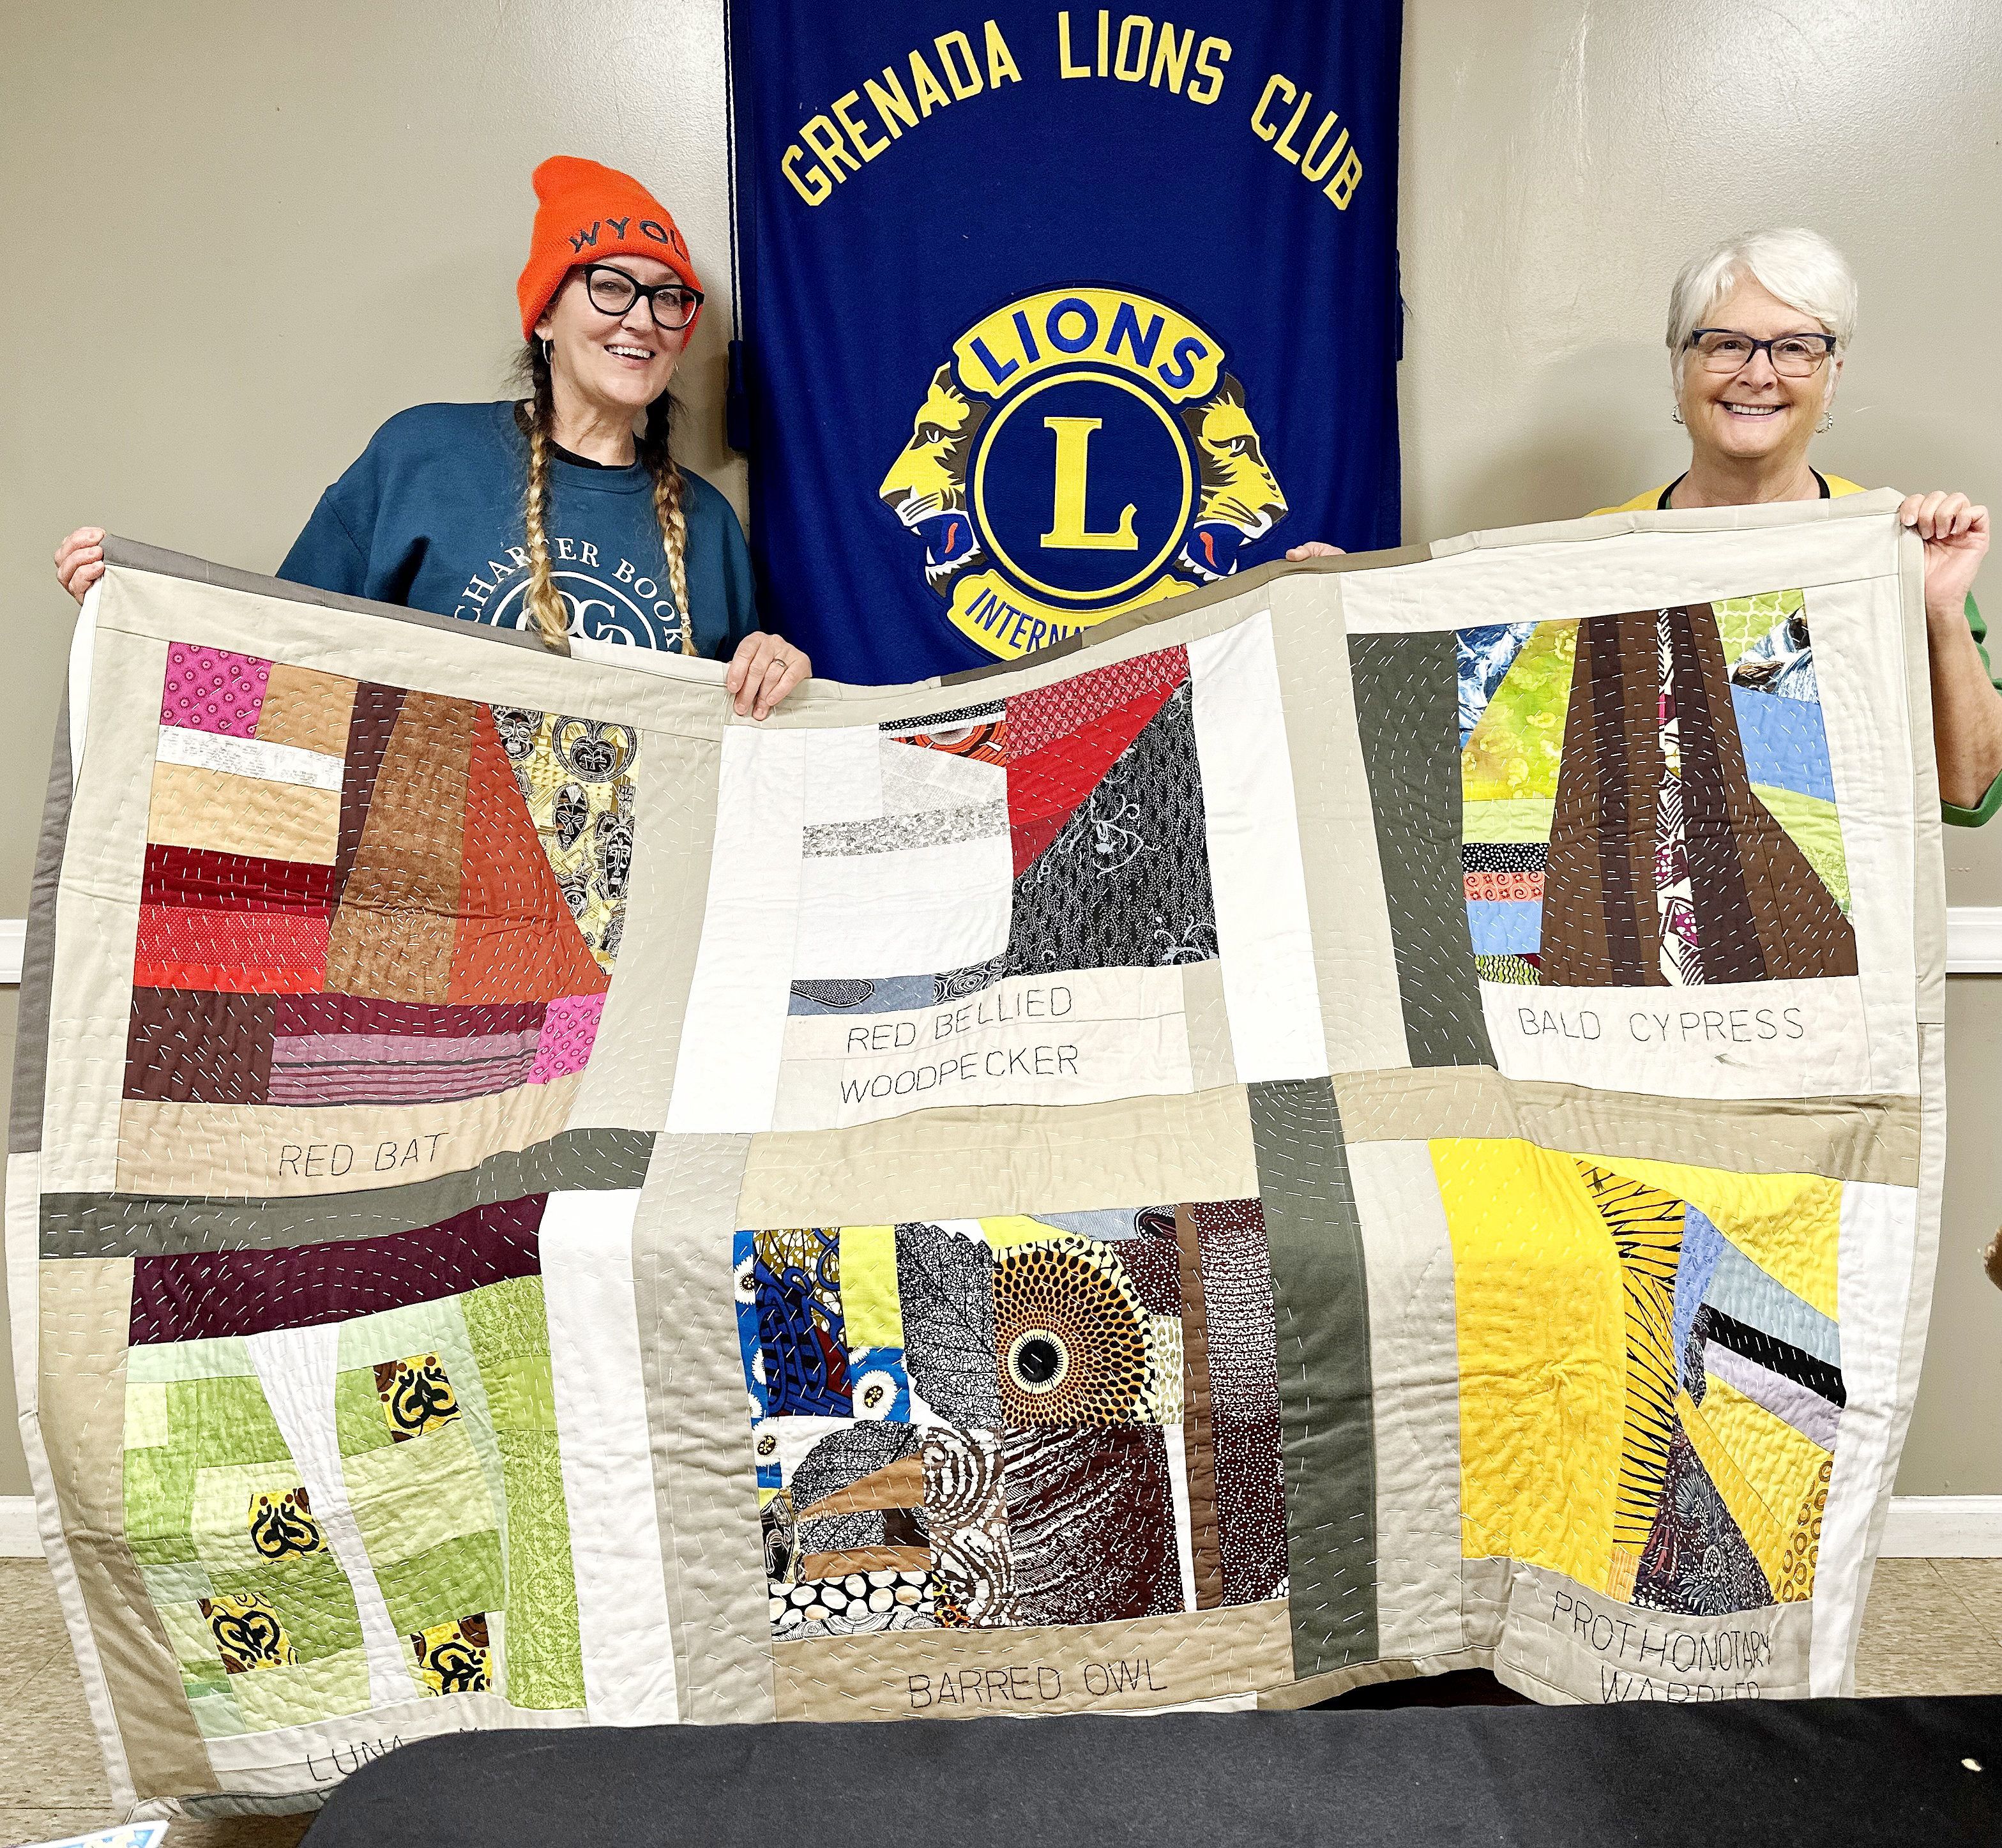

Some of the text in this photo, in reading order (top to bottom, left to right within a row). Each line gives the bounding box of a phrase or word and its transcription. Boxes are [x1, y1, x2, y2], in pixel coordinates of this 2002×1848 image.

[782, 10, 1362, 211] GRENADA LIONS CLUB
[970, 298, 1208, 390] LIONS
[1040, 416, 1139, 550] L
[454, 538, 600, 623] CHARER
[612, 558, 683, 653] BOOK
[964, 587, 1095, 653] INTERN
[848, 987, 1072, 1053] RED BELLIED
[1518, 1008, 1805, 1042] BALD CYPRESS
[840, 1045, 1079, 1103] WOODPECKER
[279, 1132, 449, 1177] RED BAT
[1552, 1591, 1771, 1672] PROTHONOTARY
[908, 1658, 1168, 1708] BARRED OWL
